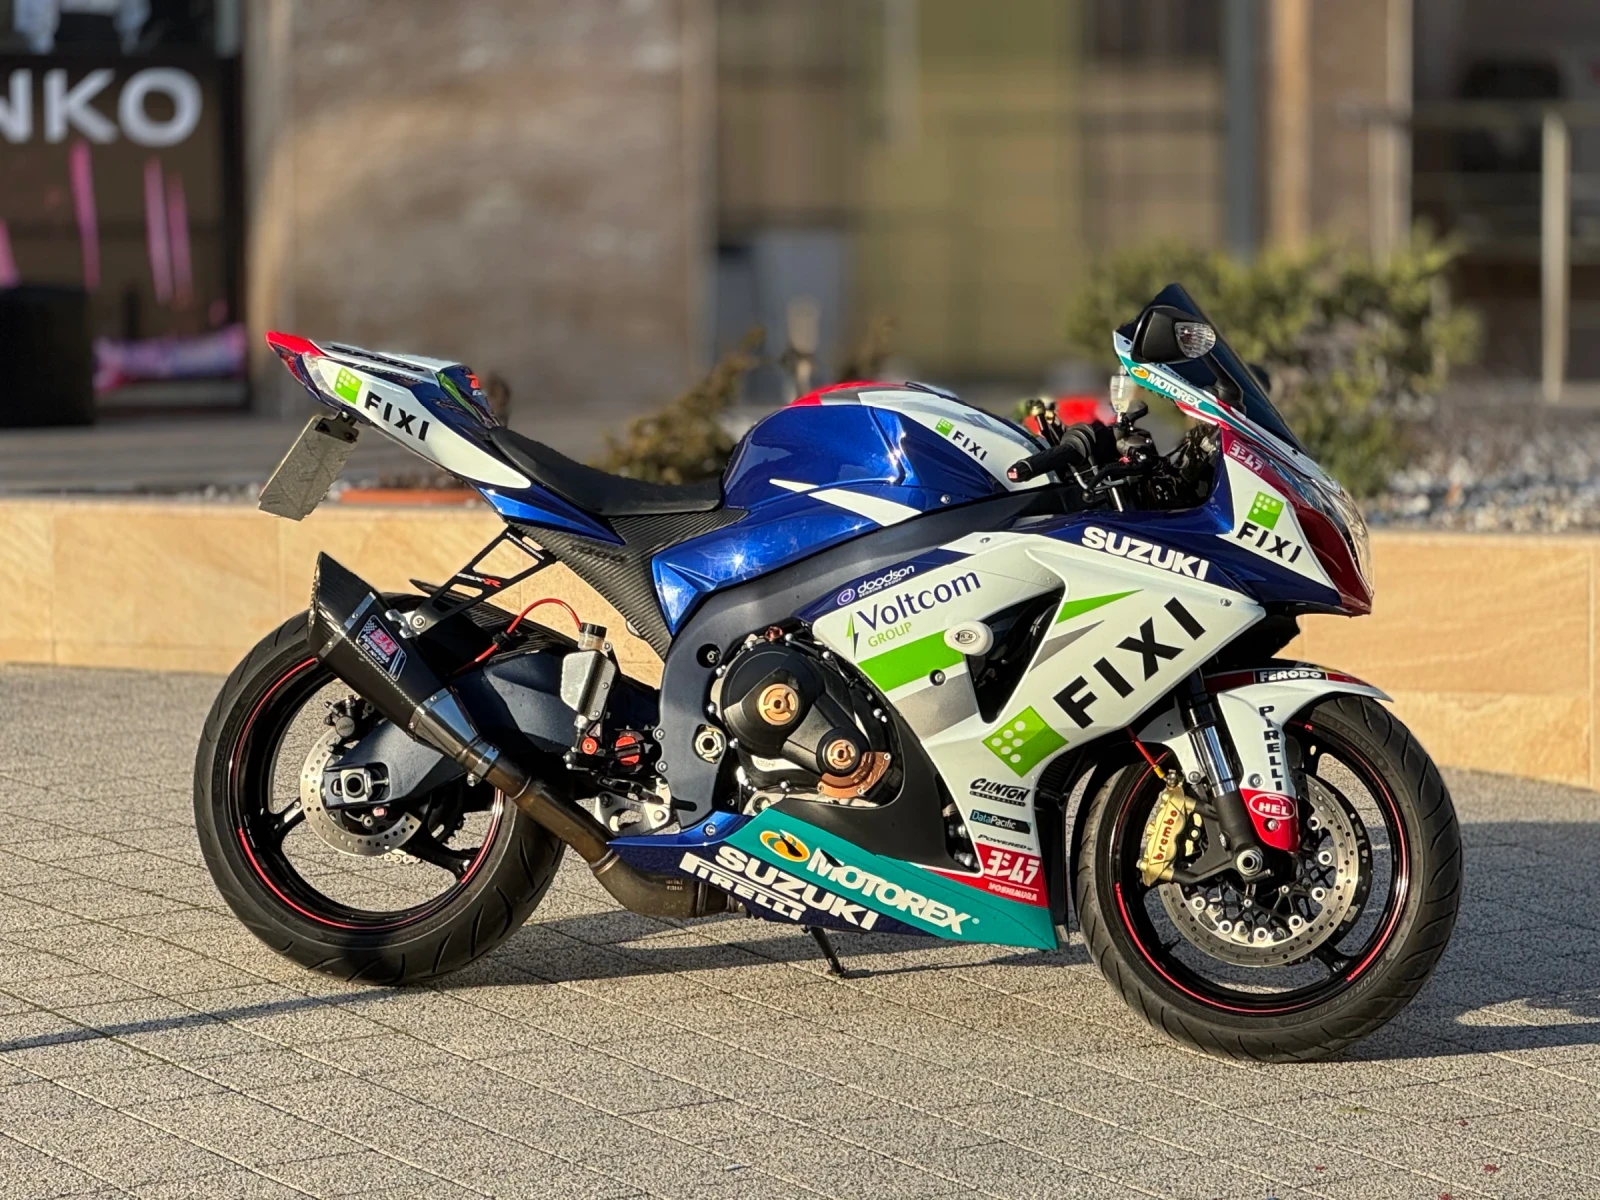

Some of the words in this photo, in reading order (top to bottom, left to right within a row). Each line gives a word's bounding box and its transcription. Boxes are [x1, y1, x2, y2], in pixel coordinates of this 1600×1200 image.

[1146, 372, 1203, 409] MOTOREX
[364, 390, 430, 442] FIXI
[951, 430, 988, 461] FIXI
[1230, 442, 1264, 472] ヨシムラ
[1081, 526, 1211, 581] SUZUKI
[1236, 522, 1303, 565] FIXI
[857, 565, 915, 594] doodson
[856, 571, 982, 632] Voltcom
[868, 622, 912, 648] GROUP
[1052, 597, 1206, 729] FIXI
[1259, 670, 1322, 681] FERODO
[1259, 705, 1283, 792] PIRELLI
[970, 778, 1031, 801] CLINTON
[972, 810, 1017, 830] DataPacific
[1258, 802, 1290, 816] HEL
[977, 834, 1026, 849] POWERED
[1153, 809, 1178, 861] brembo
[678, 851, 807, 921] PIRELLI
[984, 850, 1040, 885] ヨシムラ
[714, 846, 879, 931] SUZUKI
[806, 847, 971, 935] MOTOREX
[988, 882, 1038, 902] YOSHIMURA
[1331, 960, 1387, 1008] SPORTEC
